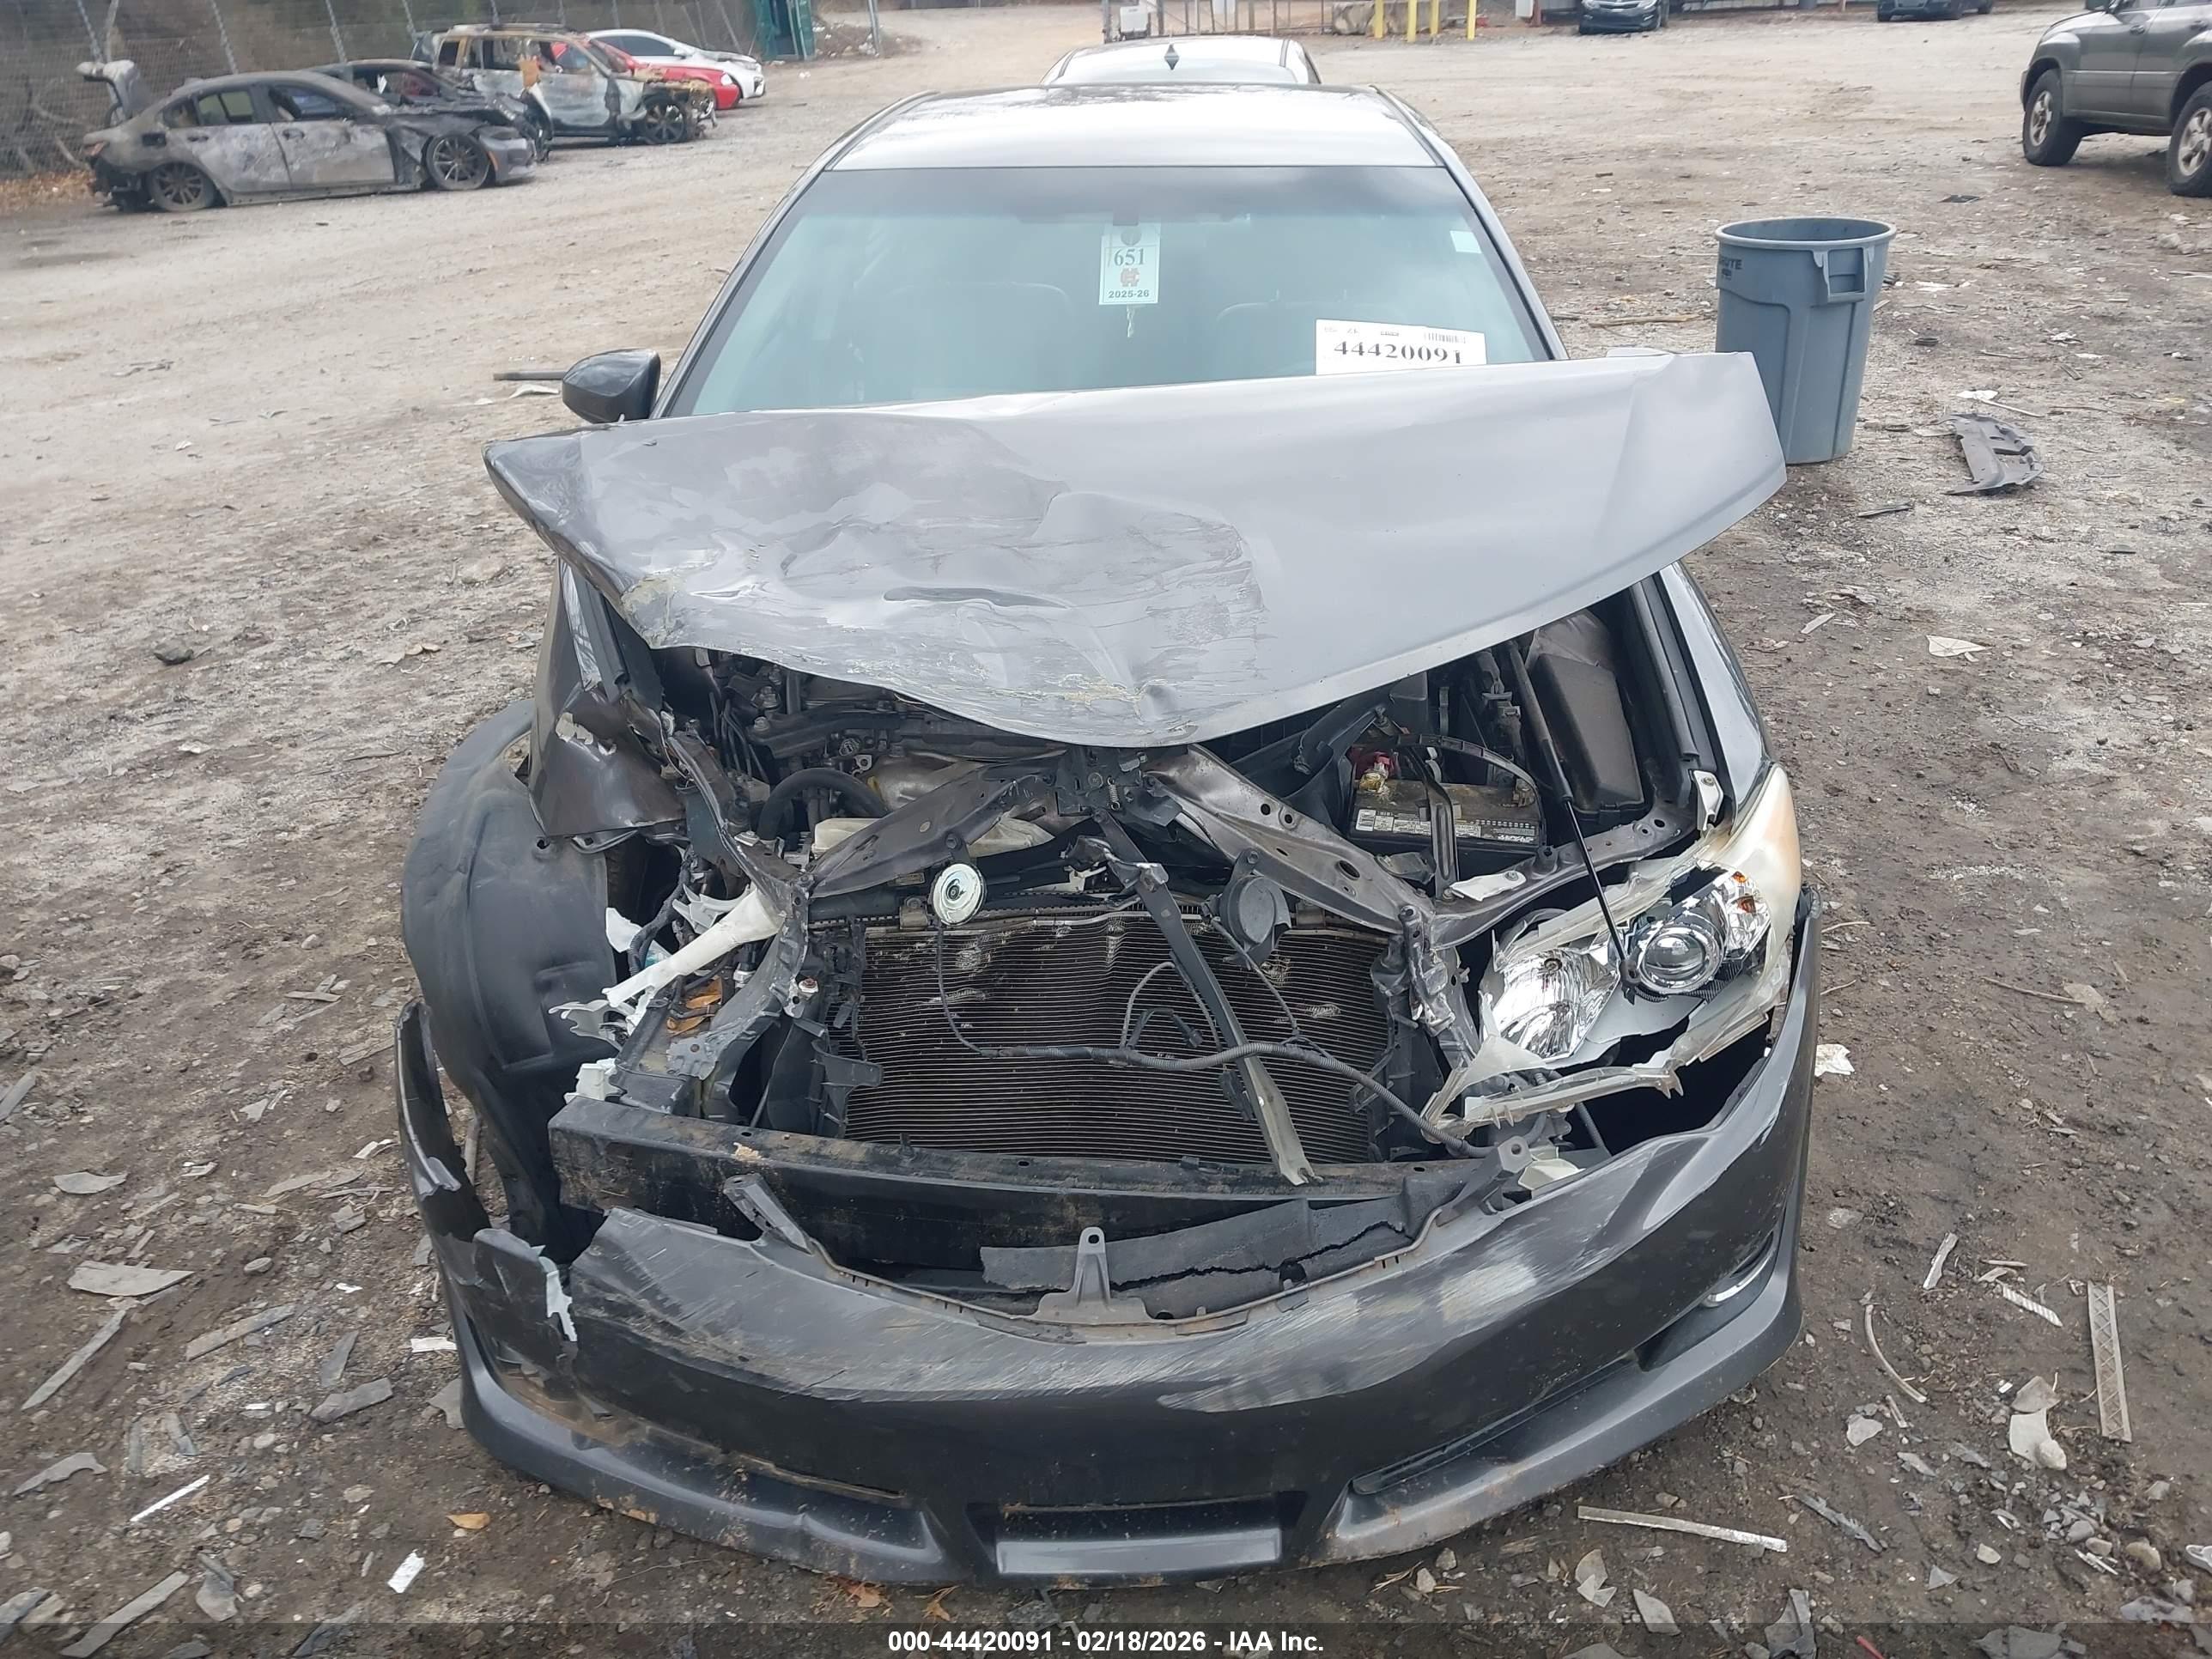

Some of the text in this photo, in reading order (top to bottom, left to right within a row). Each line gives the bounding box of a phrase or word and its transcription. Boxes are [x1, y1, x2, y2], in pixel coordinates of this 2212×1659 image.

[1114, 248, 1145, 266] 651
[1108, 289, 1150, 299] 2025-26
[1334, 340, 1462, 364] 44420091
